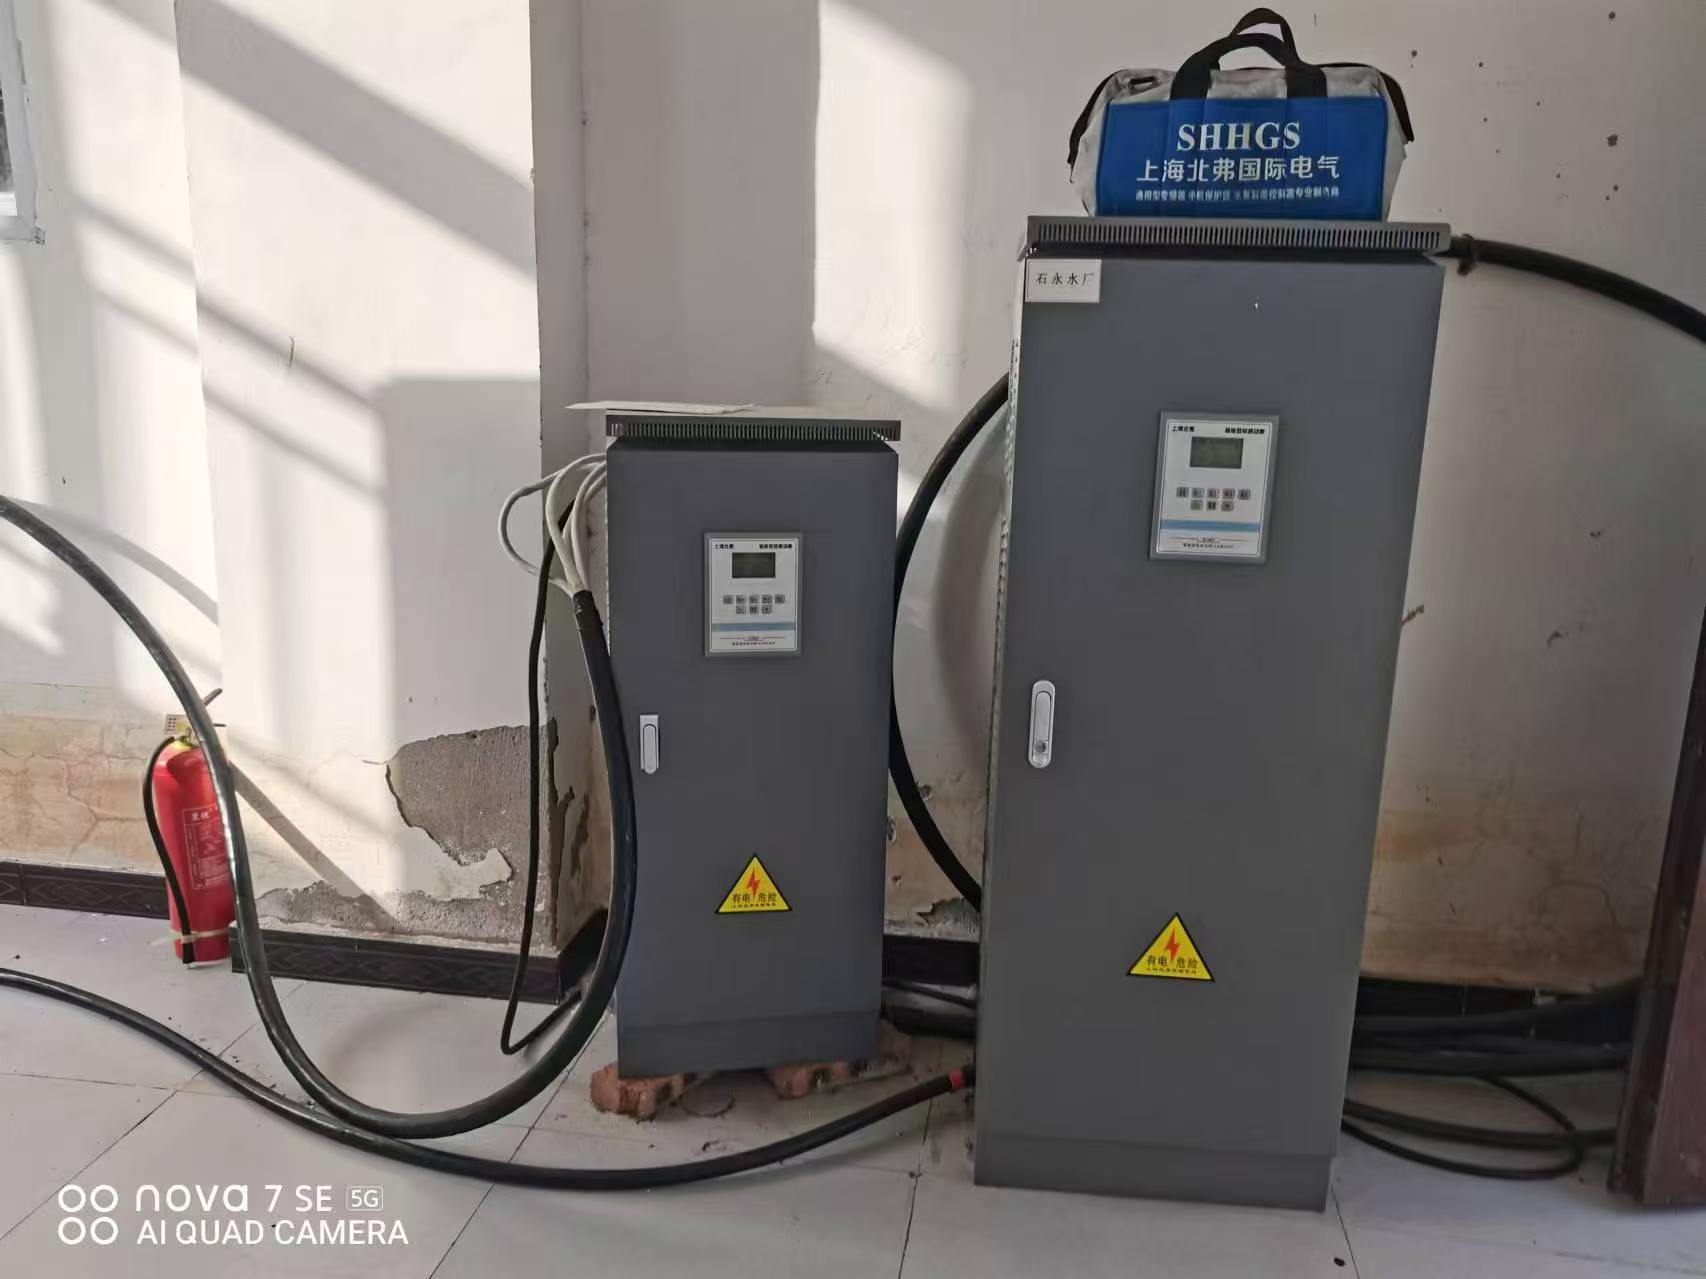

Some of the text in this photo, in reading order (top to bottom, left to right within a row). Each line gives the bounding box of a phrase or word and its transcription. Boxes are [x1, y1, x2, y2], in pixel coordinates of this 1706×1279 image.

[1176, 122, 1301, 151] SHHGS
[1136, 155, 1340, 183] 上海北弗国际电气
